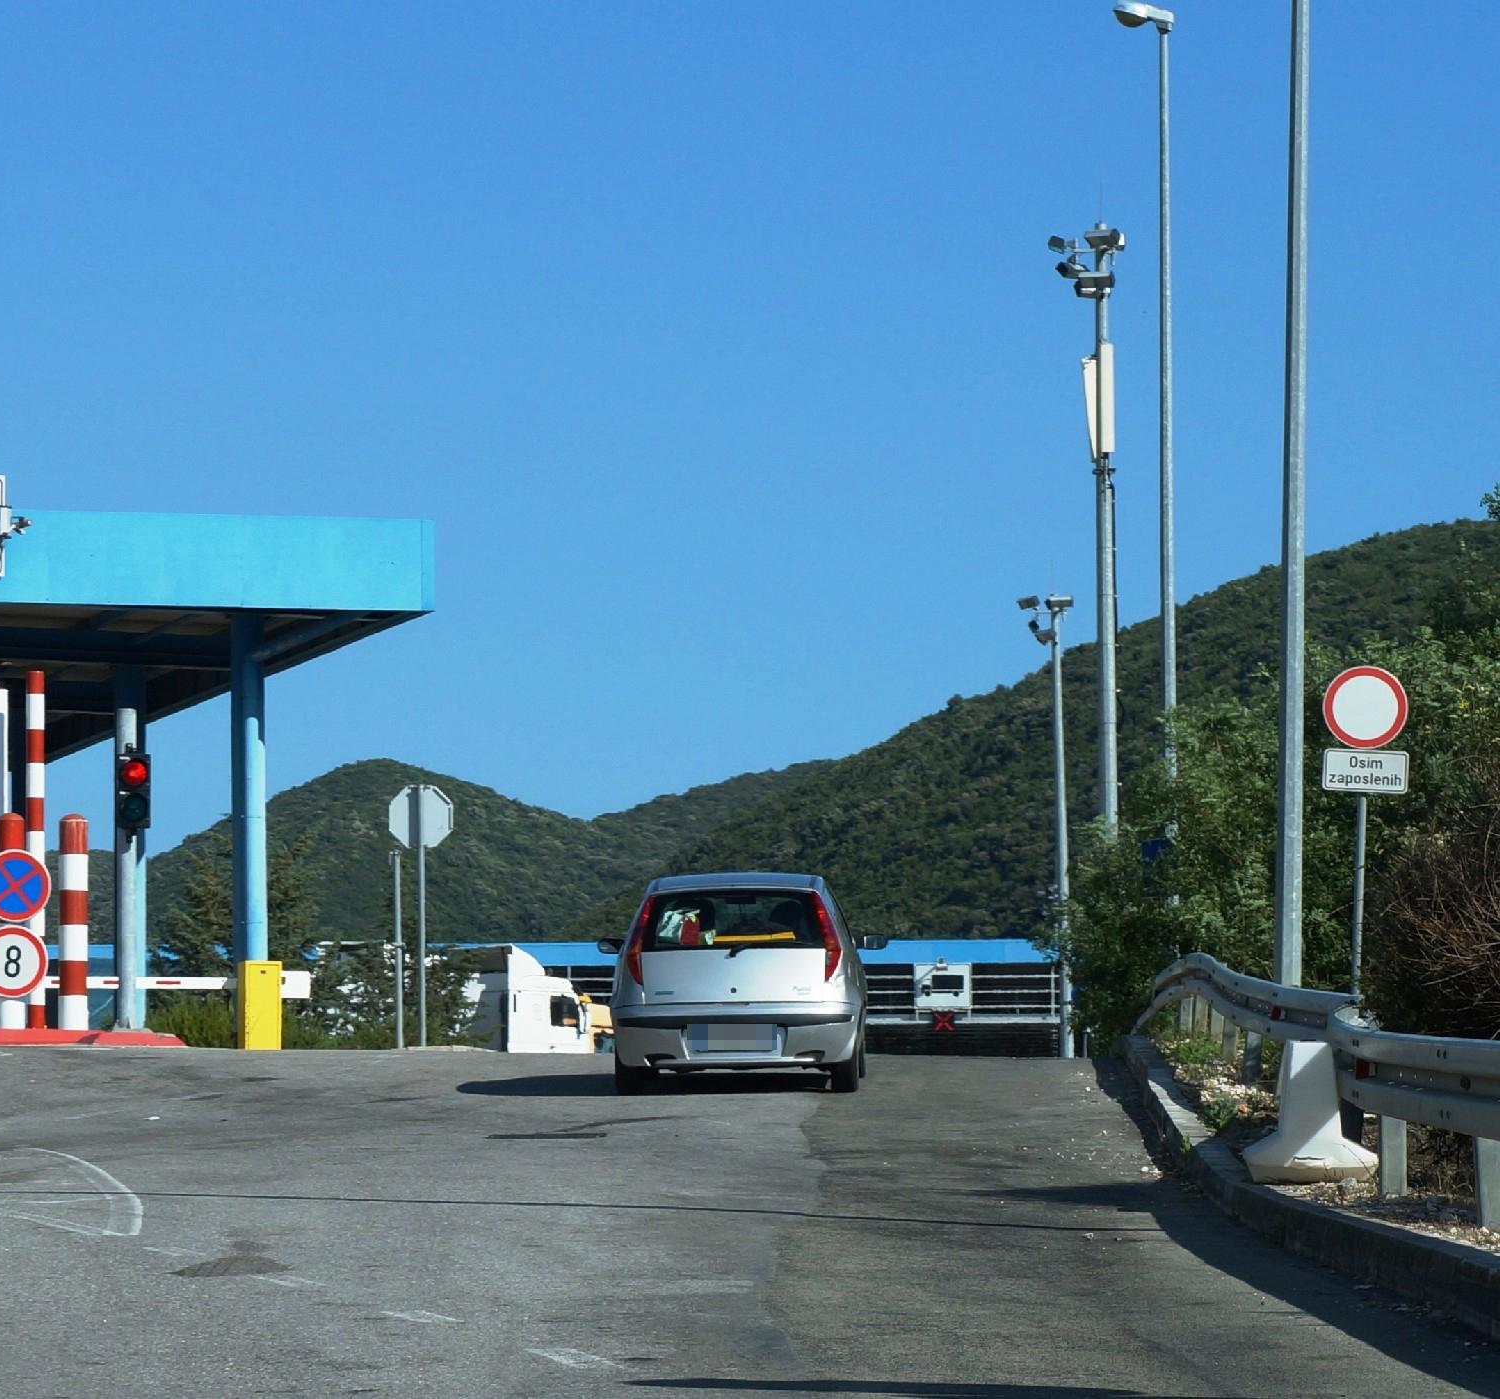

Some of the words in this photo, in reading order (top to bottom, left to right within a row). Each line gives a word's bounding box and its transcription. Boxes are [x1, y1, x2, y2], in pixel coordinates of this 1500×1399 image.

[1349, 755, 1383, 769] Osim
[1328, 773, 1402, 786] zaposlenih
[4, 944, 21, 978] 8
